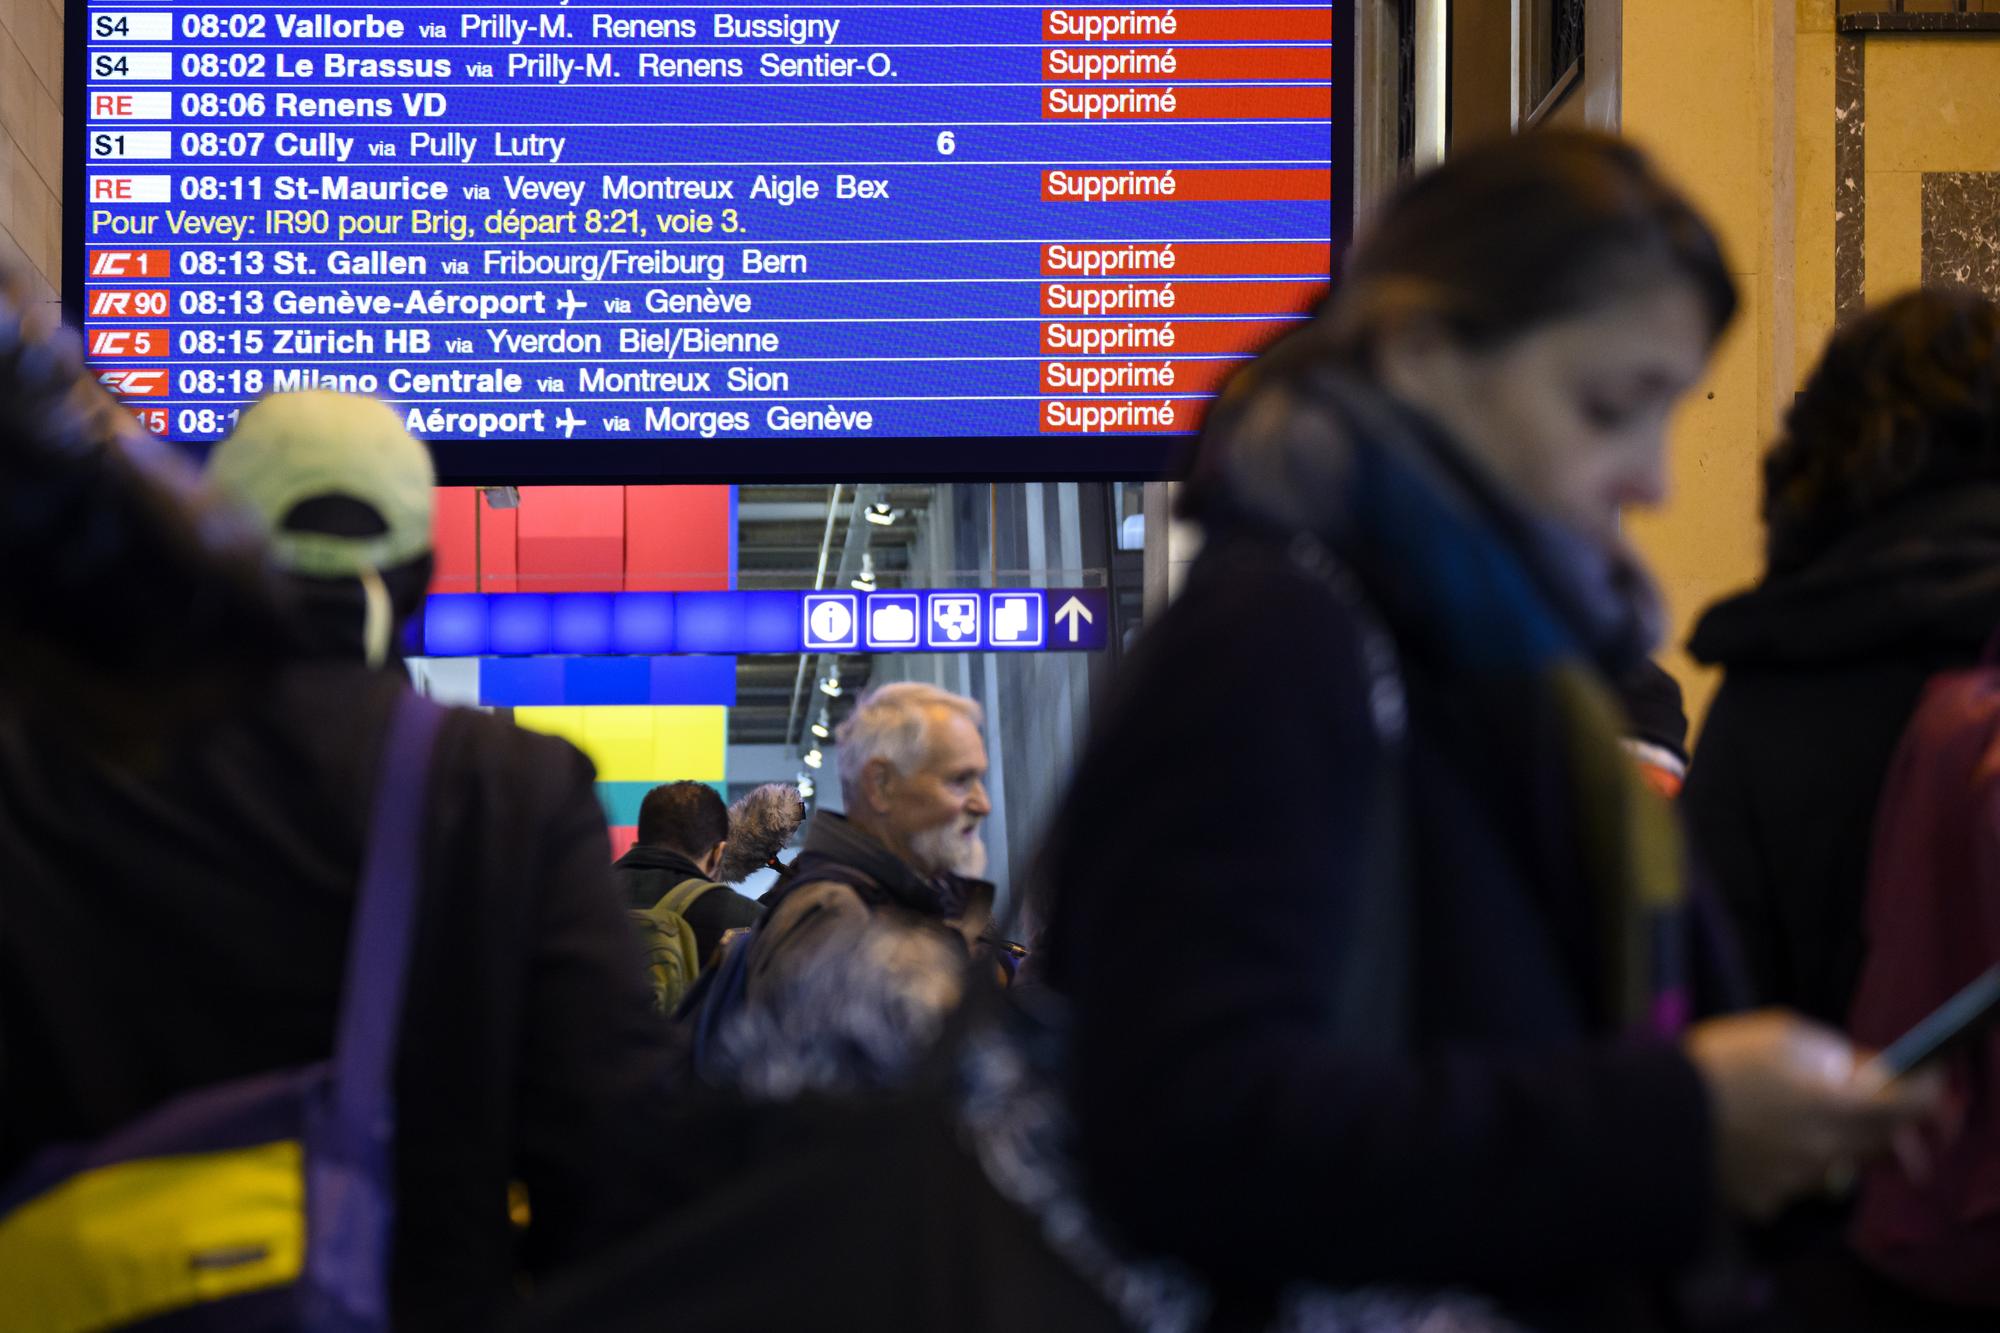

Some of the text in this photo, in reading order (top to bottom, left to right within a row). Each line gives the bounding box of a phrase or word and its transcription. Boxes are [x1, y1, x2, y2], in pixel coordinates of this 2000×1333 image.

[96, 9, 1176, 44] S4 08:02 Vallorbe via Prilly-M. Renens Bussigny Supprimé
[96, 48, 1176, 84] S4 08:02 Le Brassus via Prilly-M. Renens Sentier-O. Supprimé
[96, 87, 1176, 119] RE 08:06 Renens VD Supprimé
[95, 131, 955, 163] S1 08:07 Cully via Pully Lutry 6
[95, 170, 1175, 206] RE 08:11 St-Maurice via Vevey Montreux Aigle Bex Supprimé
[93, 208, 746, 240] Pour Vevey: IR90 pour Brig, départ 8:21, voie 3.
[92, 243, 1175, 281] IC 1 08:13 St. Gallen via Fribourg/Freiburg Bern Supprimé
[92, 282, 1175, 319] IR 90 08:13 Genève-Aéroport via Genève Supprimé
[92, 322, 1175, 355] IC 5 08:15 Zürich HB via Yverdon Biel/Bienne Supprimé
[178, 369, 263, 393] 08:18
[273, 369, 378, 393] Milano
[389, 368, 522, 393] Centrale
[536, 377, 564, 392] via
[579, 368, 710, 392] Montreux
[727, 367, 788, 391] Sion
[1047, 361, 1174, 393] Supprimé
[178, 409, 241, 433] 08:1
[404, 408, 546, 437] Aéroport
[603, 416, 630, 431] via
[645, 407, 749, 437] Morges
[767, 405, 872, 430] Genève
[1047, 400, 1174, 432] Supprimé
